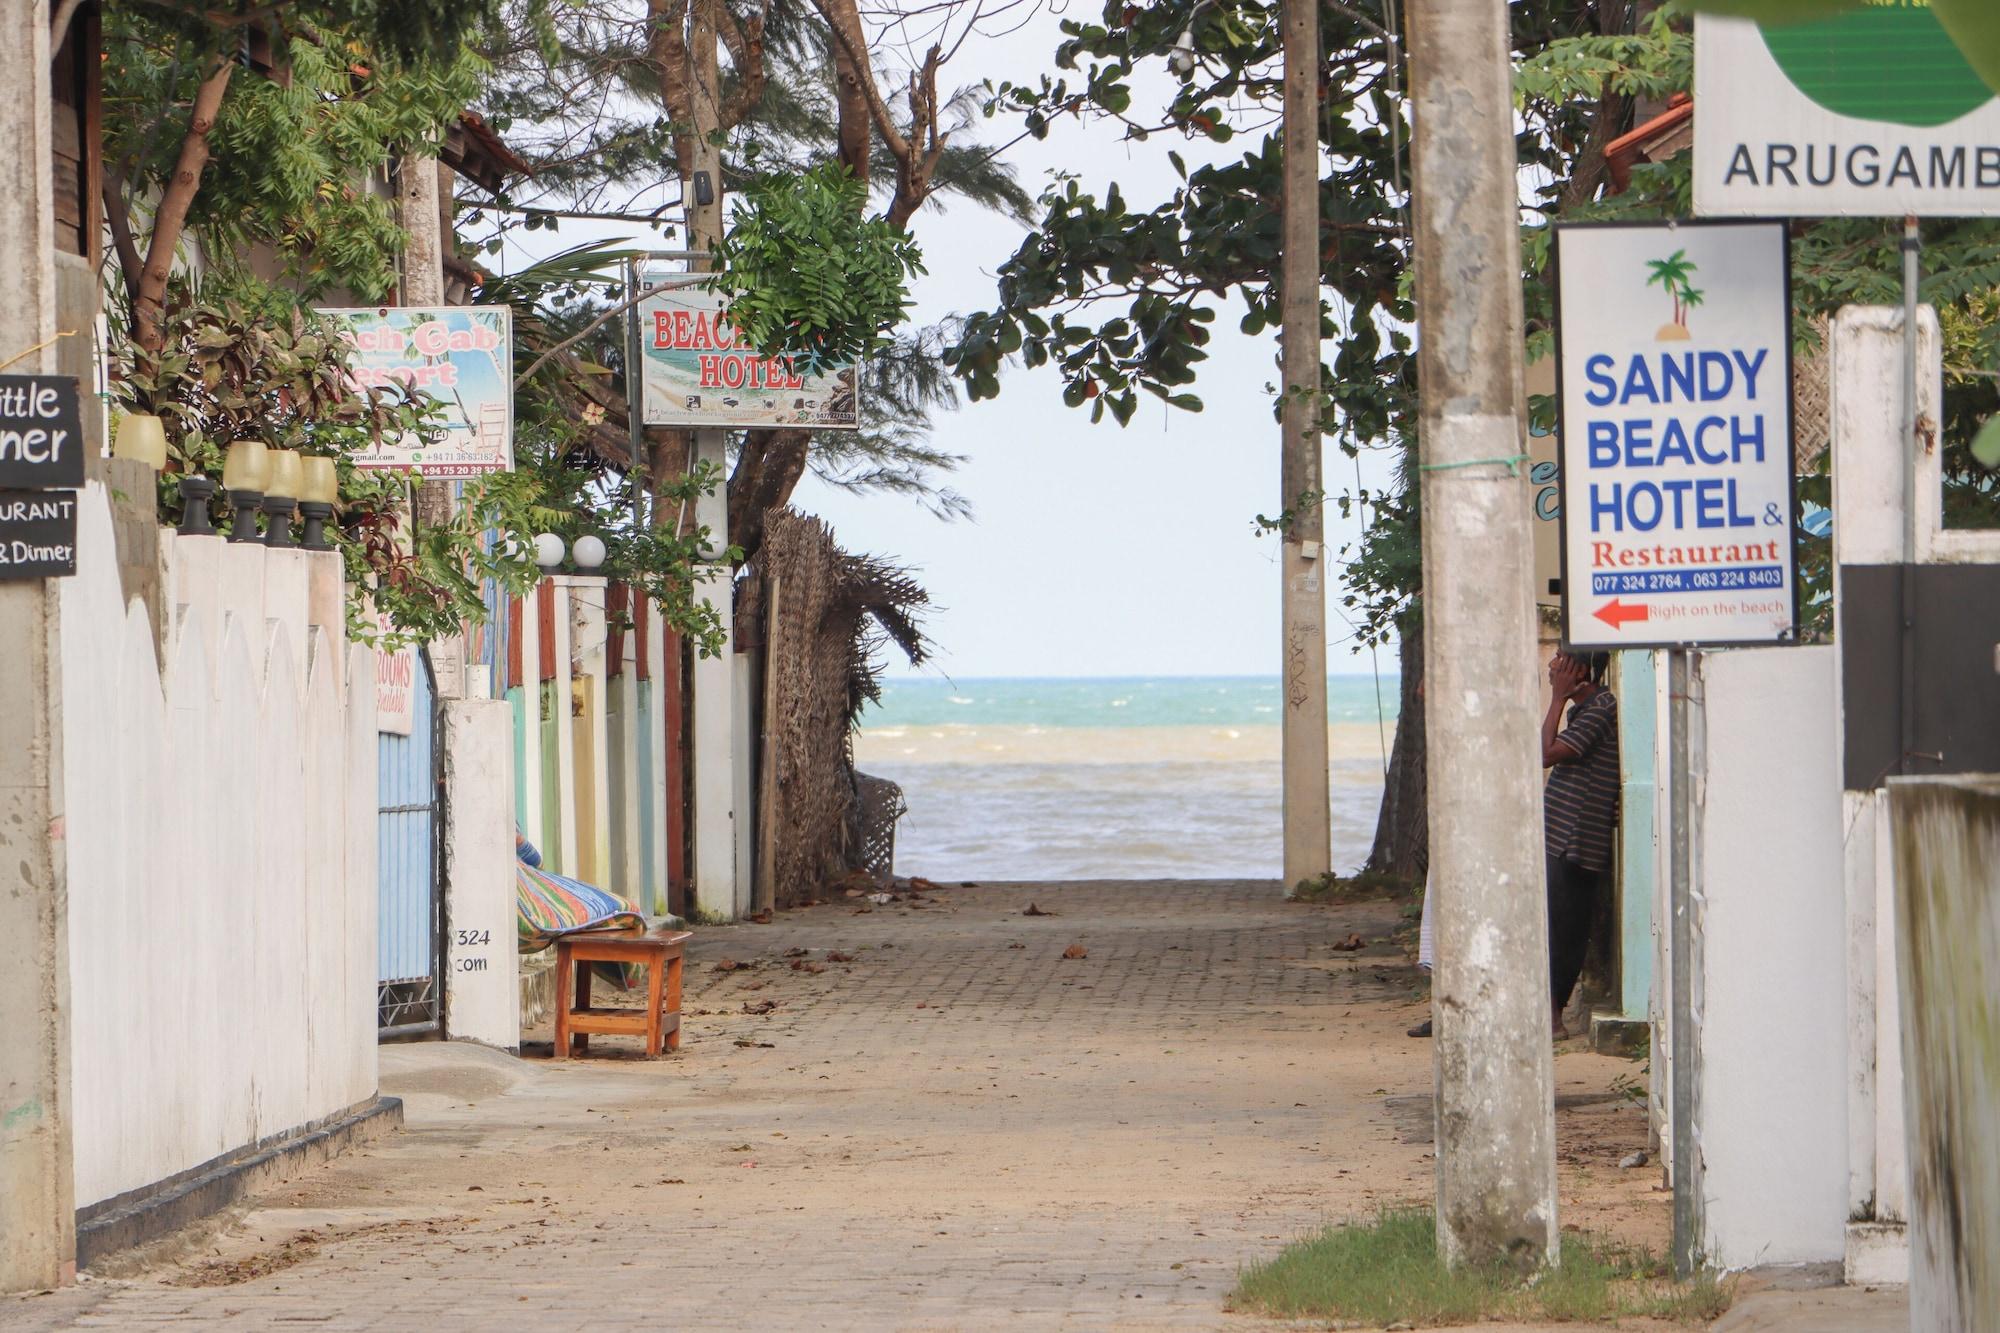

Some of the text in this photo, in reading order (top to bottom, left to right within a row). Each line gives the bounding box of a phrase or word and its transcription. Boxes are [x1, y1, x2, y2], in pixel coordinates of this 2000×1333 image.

[1724, 143, 2000, 188] ARUGAMB
[698, 355, 804, 390] HOTEL
[1585, 348, 1769, 407] SANDY
[0, 428, 68, 463] ner
[1588, 414, 1765, 469] BEACH
[423, 466, 441, 475] +94
[443, 466, 455, 475] 75
[457, 466, 469, 475] 20
[0, 501, 74, 521] URANT
[1590, 478, 1784, 533] HOTEL &
[11, 541, 72, 564] Dinner
[1591, 539, 1779, 567] Restaurant
[1594, 574, 1618, 591] 077
[1622, 573, 1646, 590] 324
[1650, 573, 1682, 589] 2764
[1693, 572, 1717, 588] 063
[1721, 571, 1745, 587] 224
[1750, 569, 1781, 586] 8403
[1650, 600, 1785, 620] Right on the beach
[458, 929, 491, 946] 324
